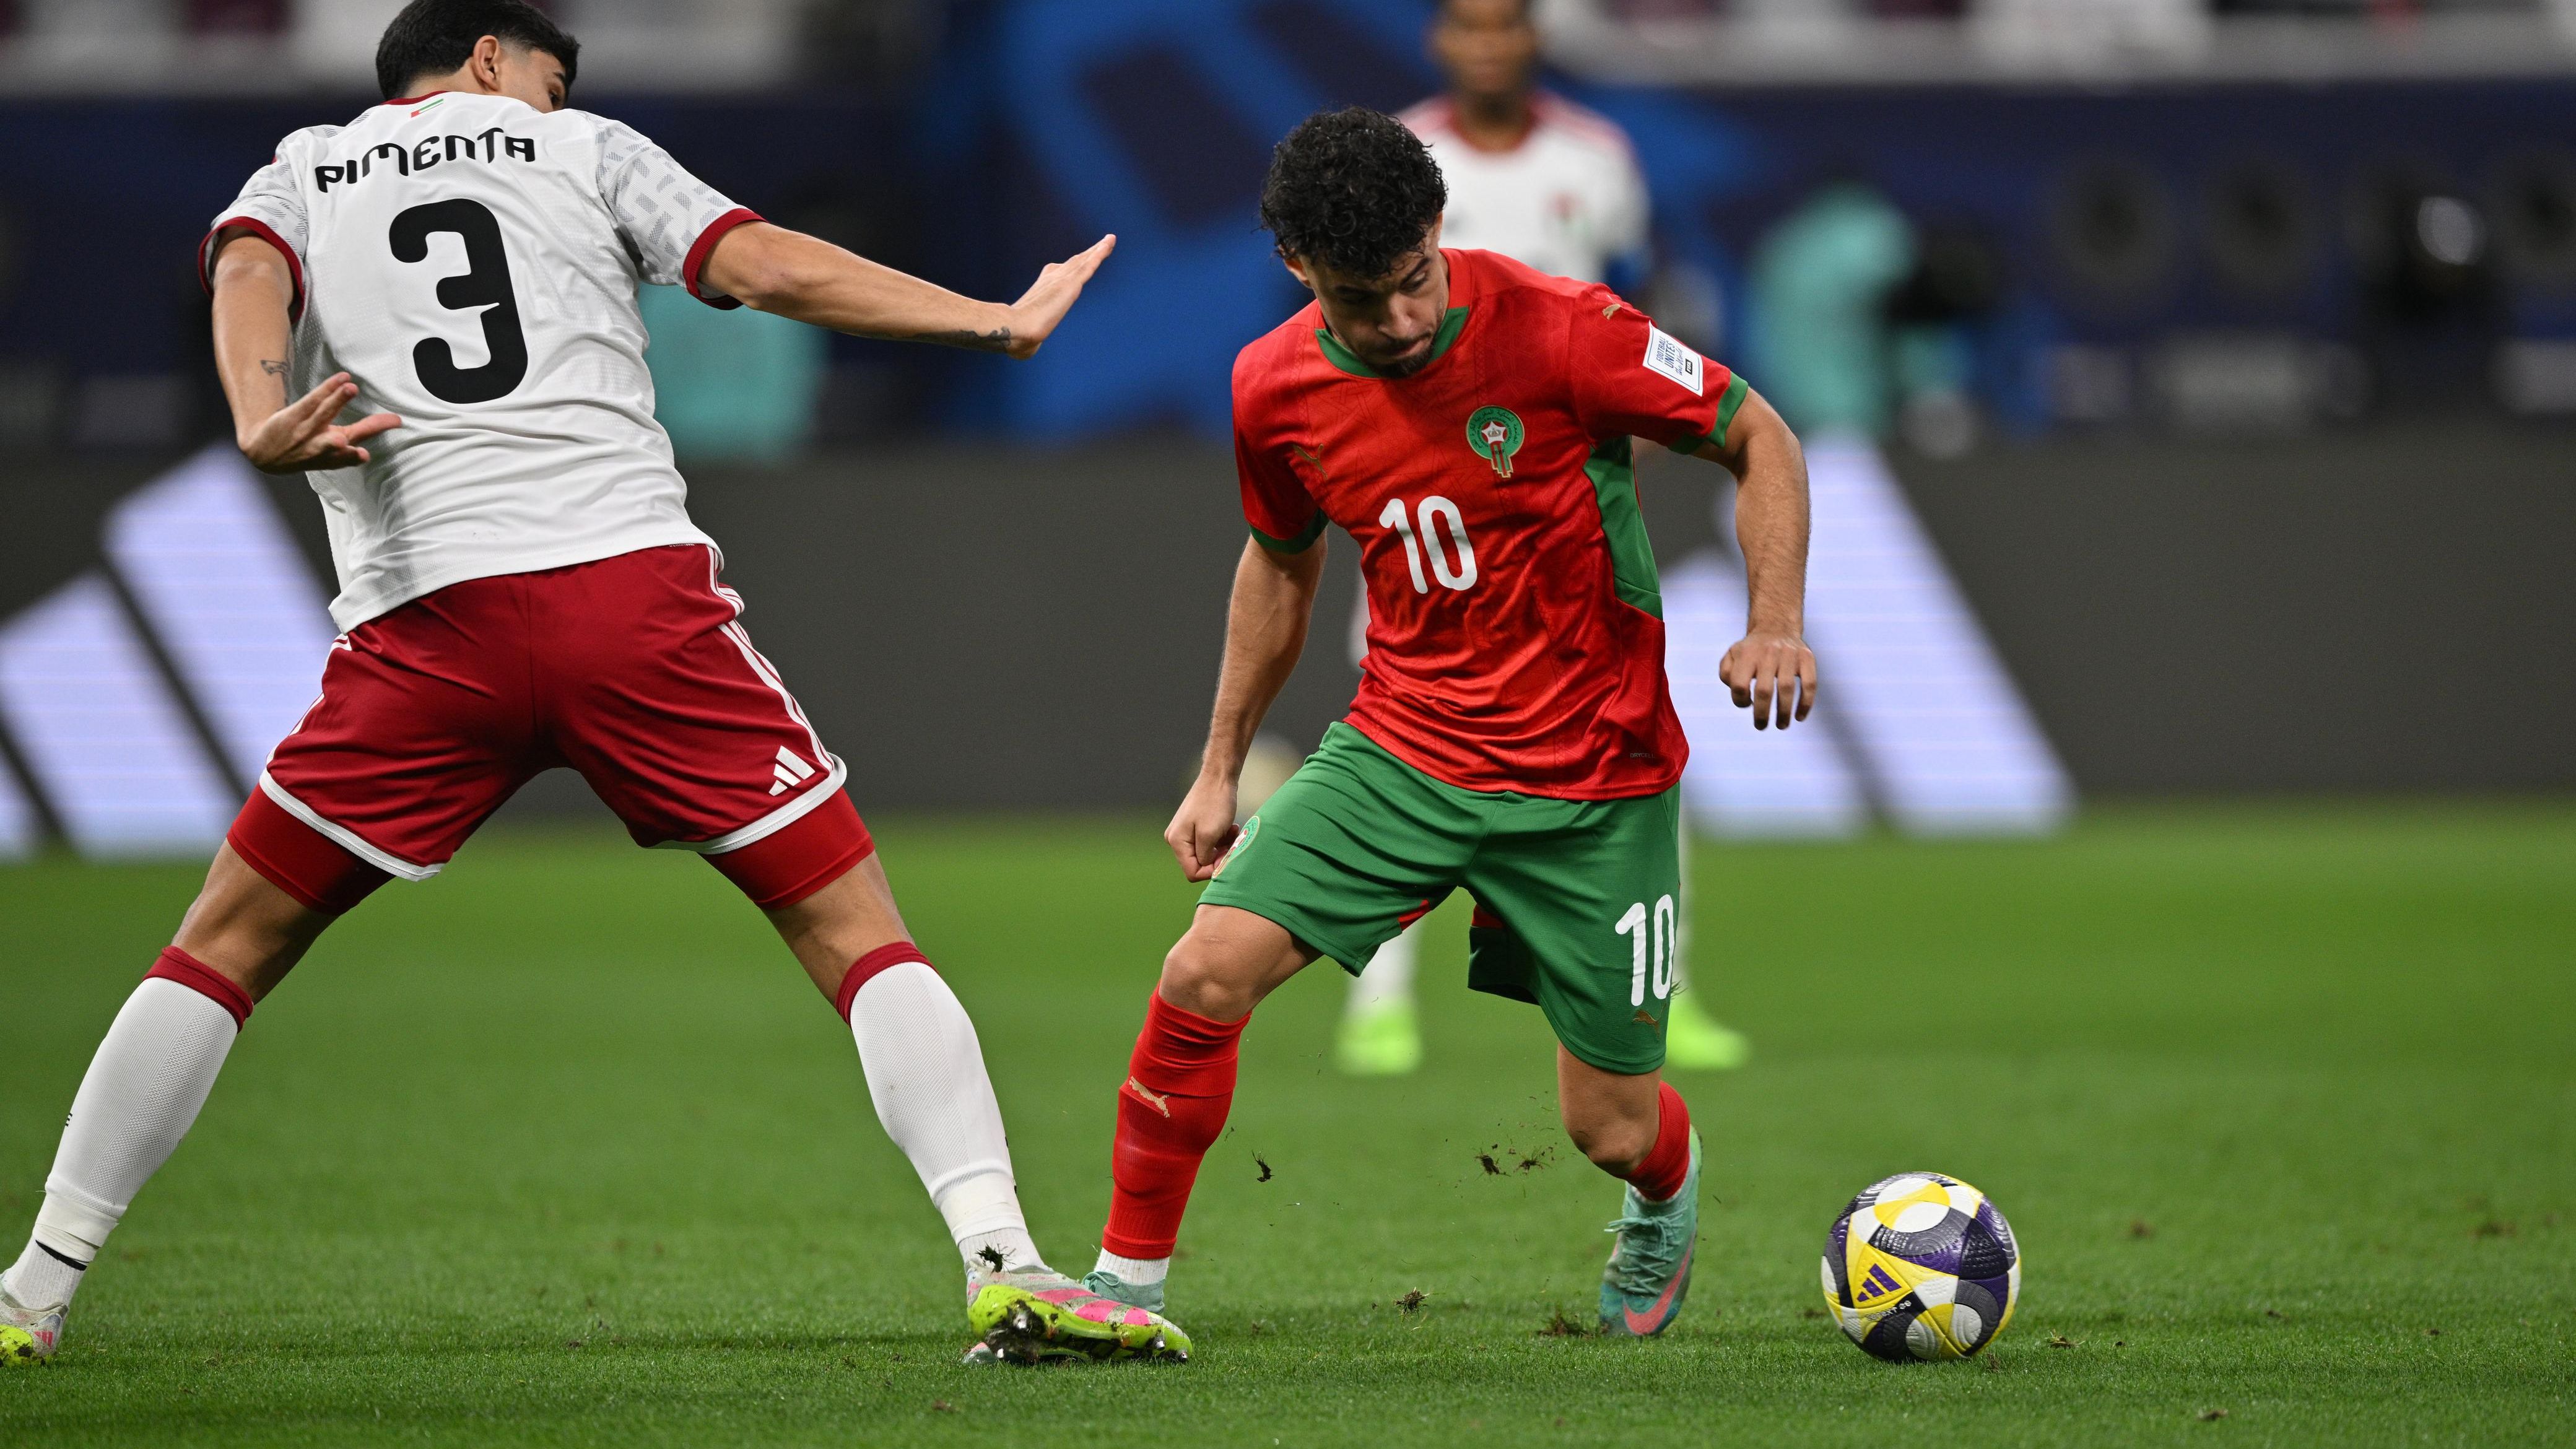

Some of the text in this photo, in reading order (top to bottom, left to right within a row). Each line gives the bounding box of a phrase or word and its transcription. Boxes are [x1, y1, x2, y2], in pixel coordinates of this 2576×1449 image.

[315, 128, 536, 193] PIMENTA
[389, 198, 528, 404] 3
[1656, 336, 1666, 363] FOOTBALL
[1664, 340, 1676, 368] UNITES
[1378, 495, 1477, 594] 10
[1615, 894, 1675, 1007] 10
